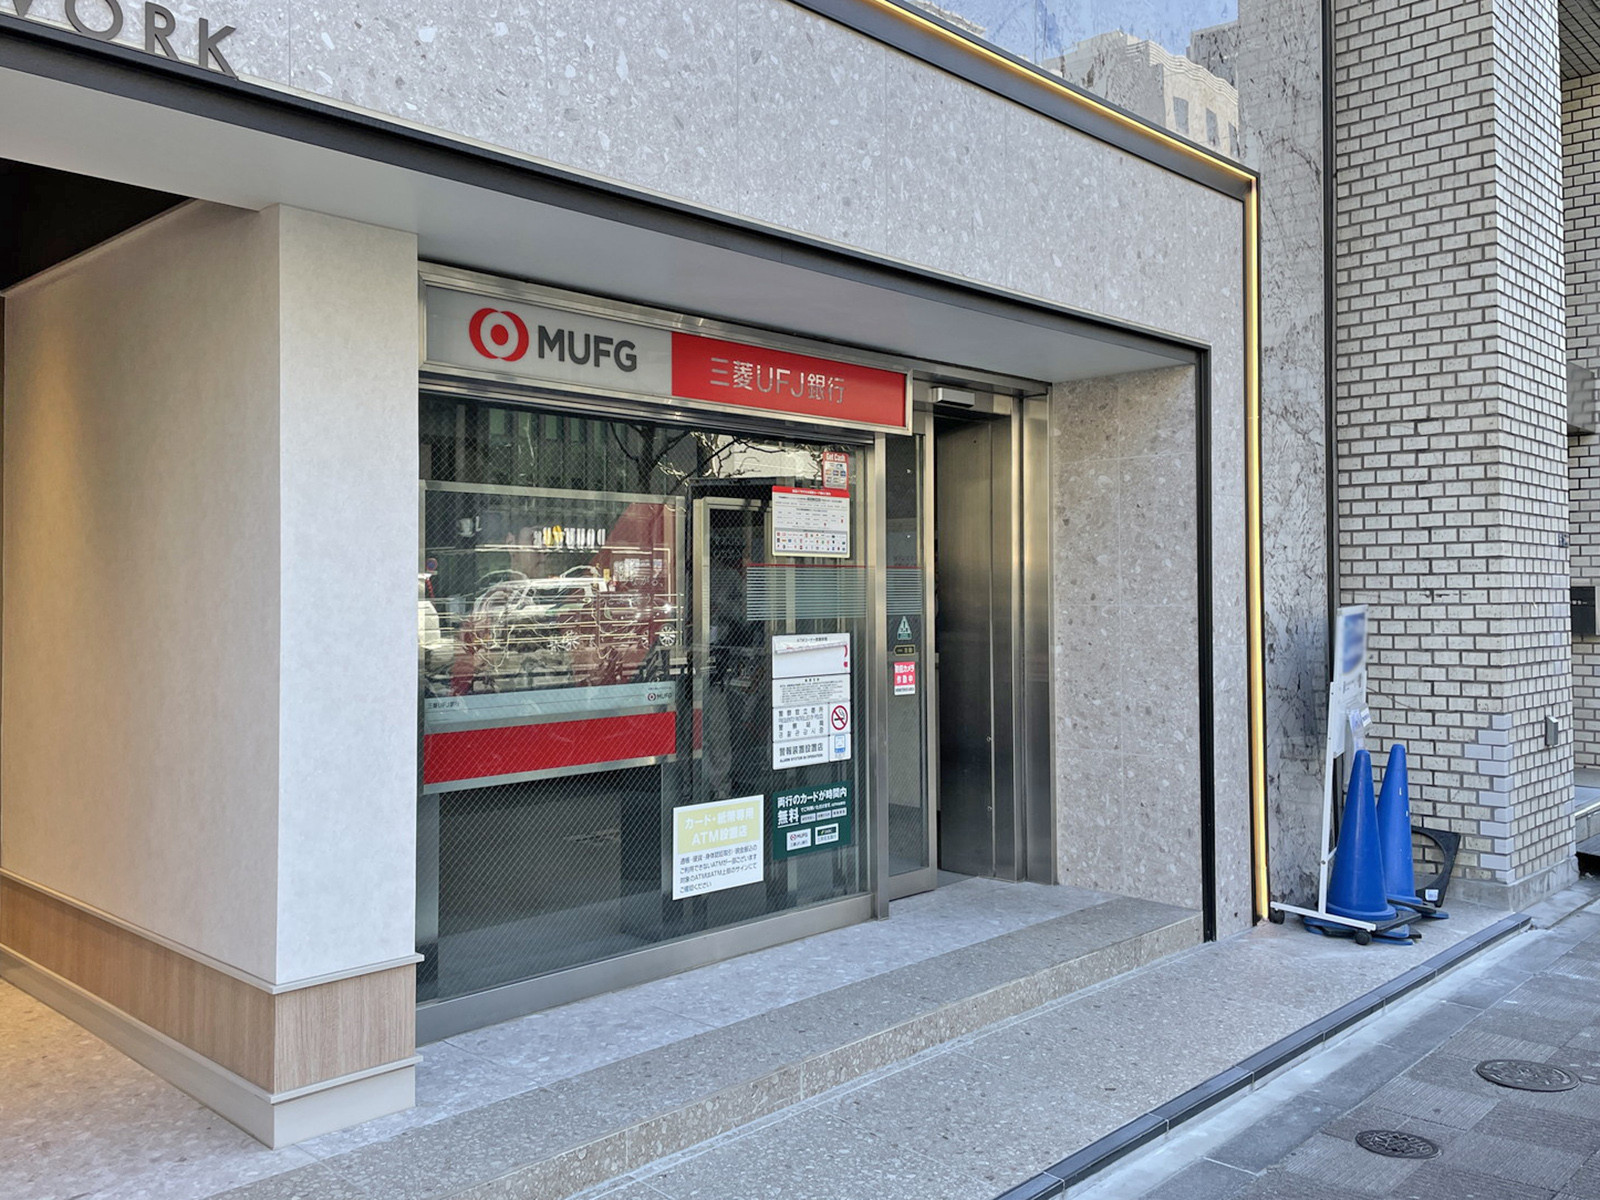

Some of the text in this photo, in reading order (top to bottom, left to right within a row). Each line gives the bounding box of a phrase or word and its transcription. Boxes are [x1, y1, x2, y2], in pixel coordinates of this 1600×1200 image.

[12, 0, 239, 80] ORK
[538, 325, 637, 372] MUFG
[710, 357, 845, 403] 三菱UFJ銀行
[779, 742, 823, 756] 警報装置設置店
[777, 786, 847, 808] 両行のカードが時間内
[777, 807, 799, 826] 無料
[692, 825, 748, 846] ATM設置店
